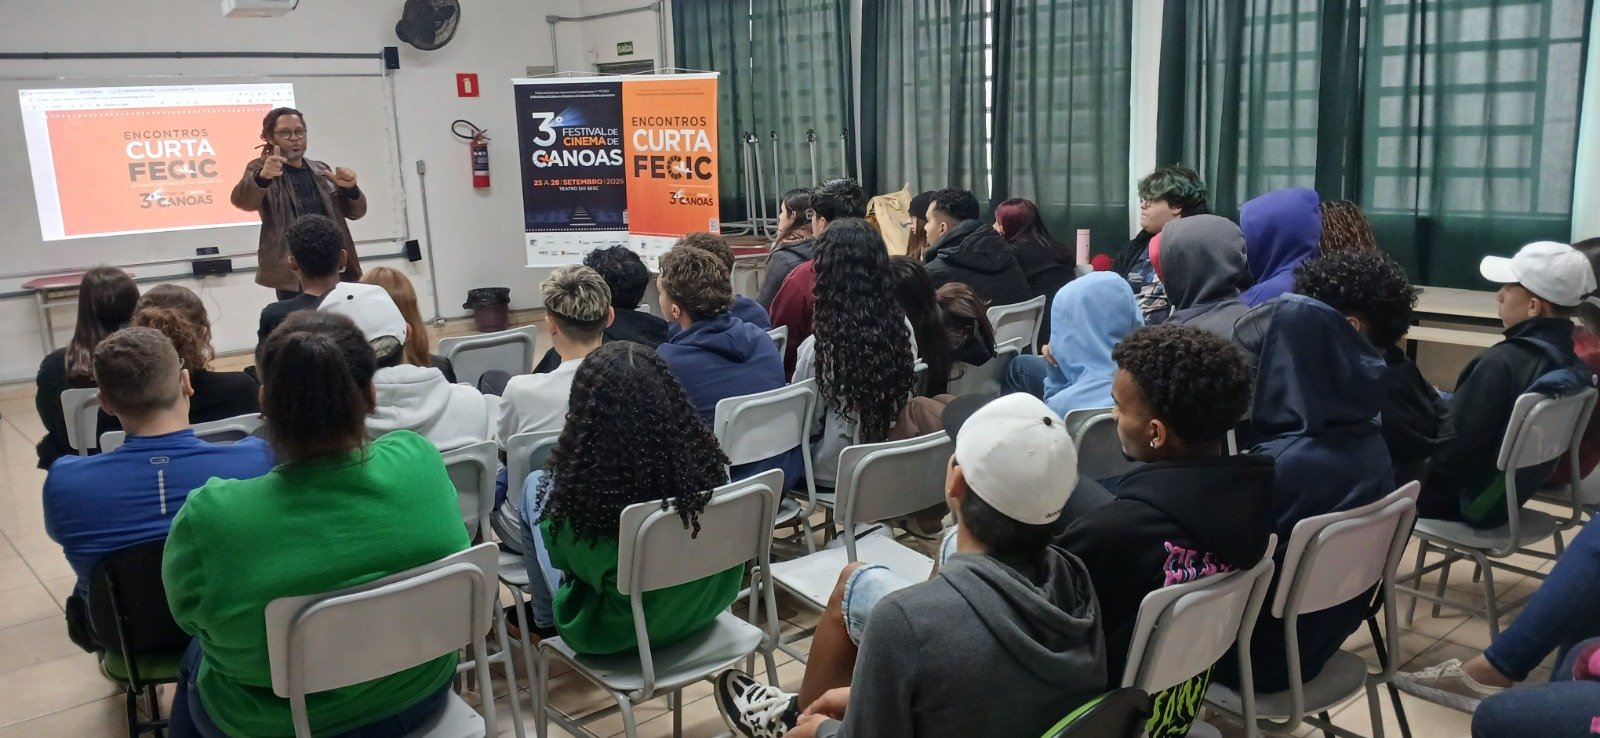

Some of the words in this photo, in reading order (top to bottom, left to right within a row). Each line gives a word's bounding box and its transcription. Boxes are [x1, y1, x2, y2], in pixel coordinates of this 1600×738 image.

[632, 116, 707, 127] ENCONTROS
[123, 129, 209, 139] ENCONTROS
[562, 127, 607, 136] FESTIVAL
[607, 128, 619, 136] DE
[563, 136, 606, 146] CINEMA
[607, 137, 620, 146] DE
[632, 128, 712, 152] CURTA
[126, 139, 216, 159] CURTA
[532, 149, 624, 168] CANOAS
[128, 159, 218, 182] FECIC
[633, 154, 713, 180] FECIC
[562, 178, 603, 186] SETEMBRO
[157, 195, 214, 208] CANOAS
[680, 197, 714, 206] CANOAS
